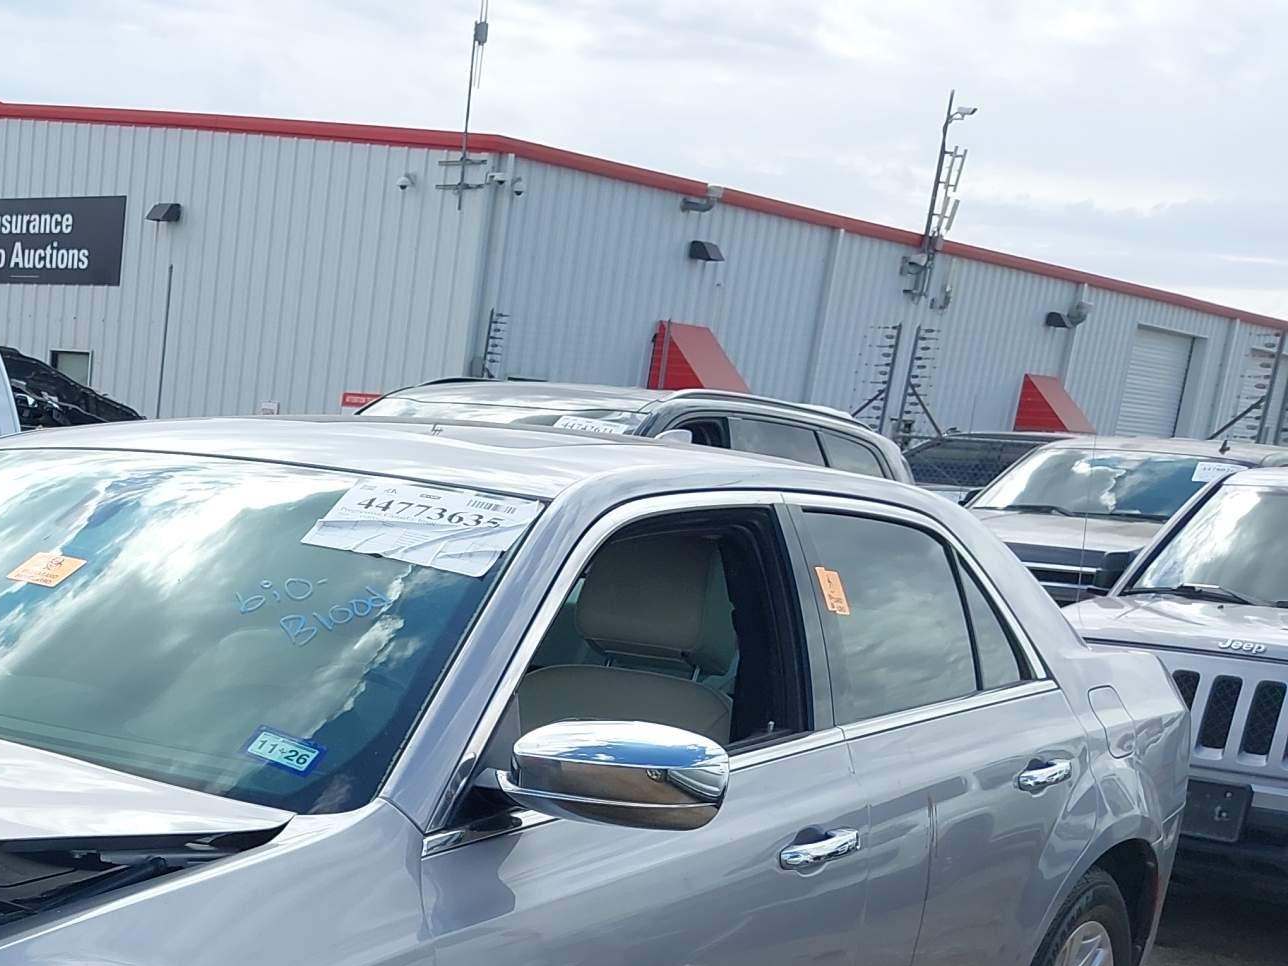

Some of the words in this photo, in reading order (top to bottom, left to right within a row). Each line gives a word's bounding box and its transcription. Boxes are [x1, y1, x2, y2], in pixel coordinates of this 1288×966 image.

[10, 241, 89, 269] Auctions
[357, 497, 505, 528] 44773635
[280, 586, 394, 646] Blood
[1218, 640, 1266, 654] Jeep
